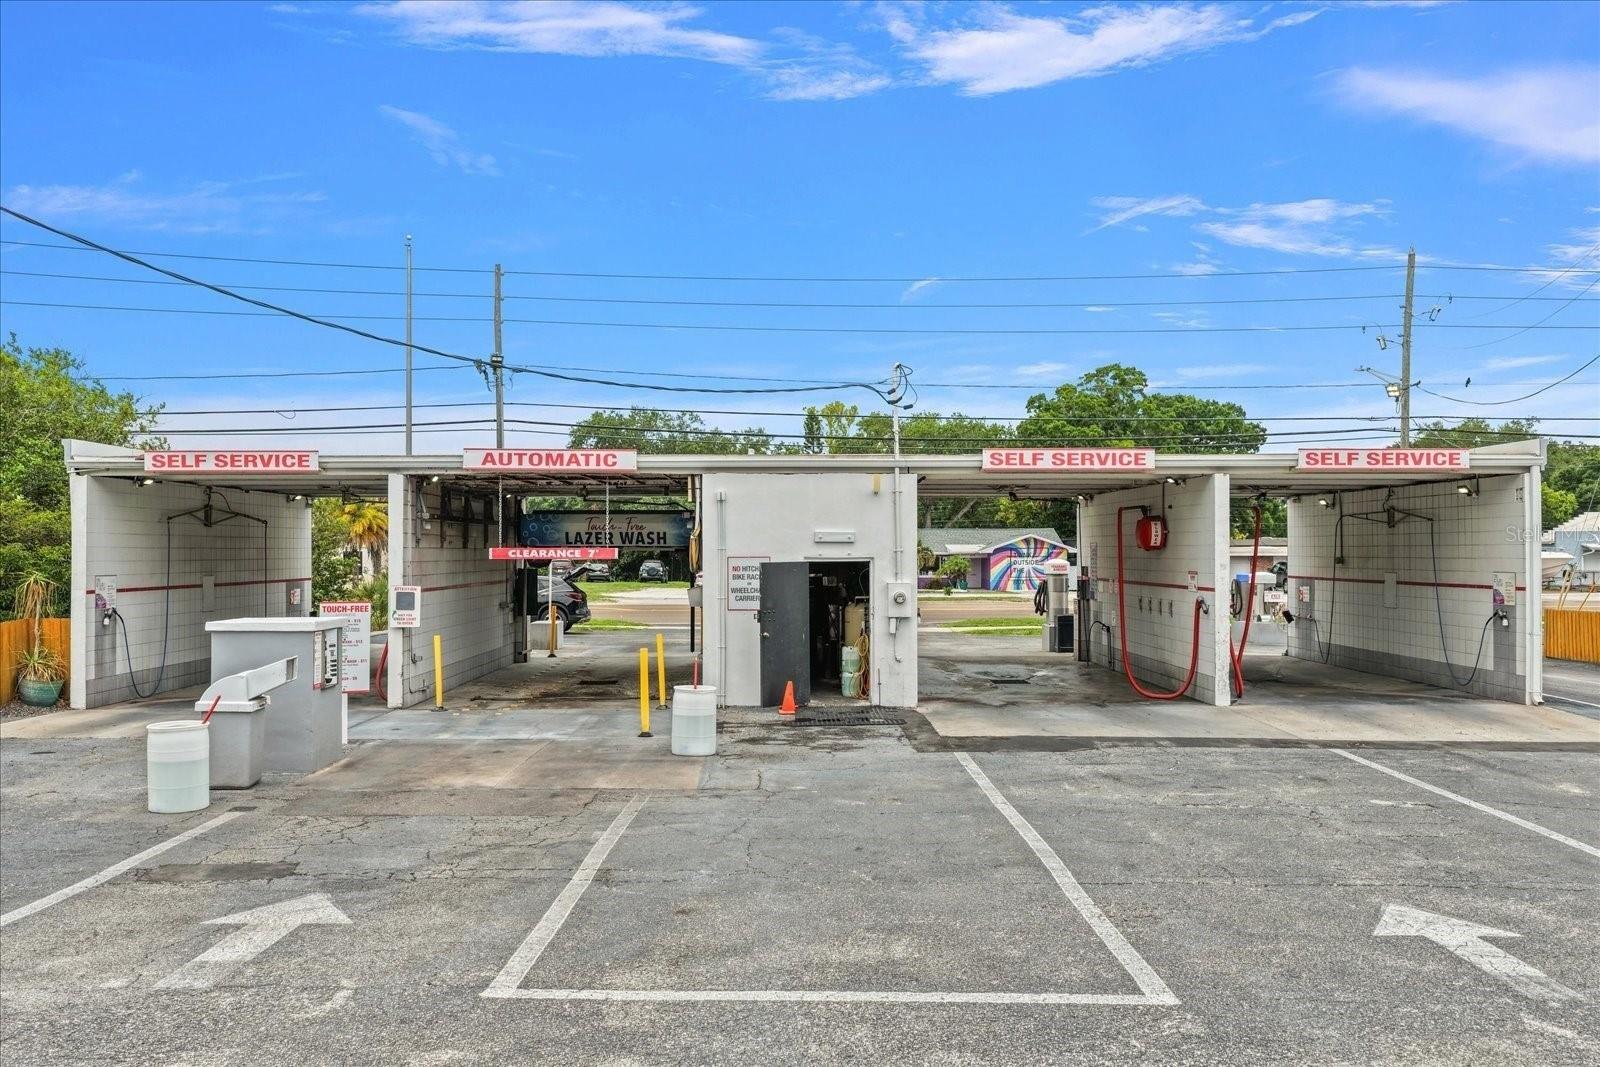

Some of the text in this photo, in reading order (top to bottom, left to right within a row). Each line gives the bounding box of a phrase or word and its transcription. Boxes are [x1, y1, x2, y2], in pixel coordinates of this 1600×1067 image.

[151, 454, 311, 468] SELF SERVICE
[481, 452, 617, 467] AUTOMATIC
[989, 452, 1147, 466] SELF SERVICE
[1305, 452, 1462, 466] SELF SERVICE
[564, 532, 667, 545] LAZER WASH
[508, 550, 581, 558] CLEARANCE
[322, 605, 369, 613] TOUCH-FREE
